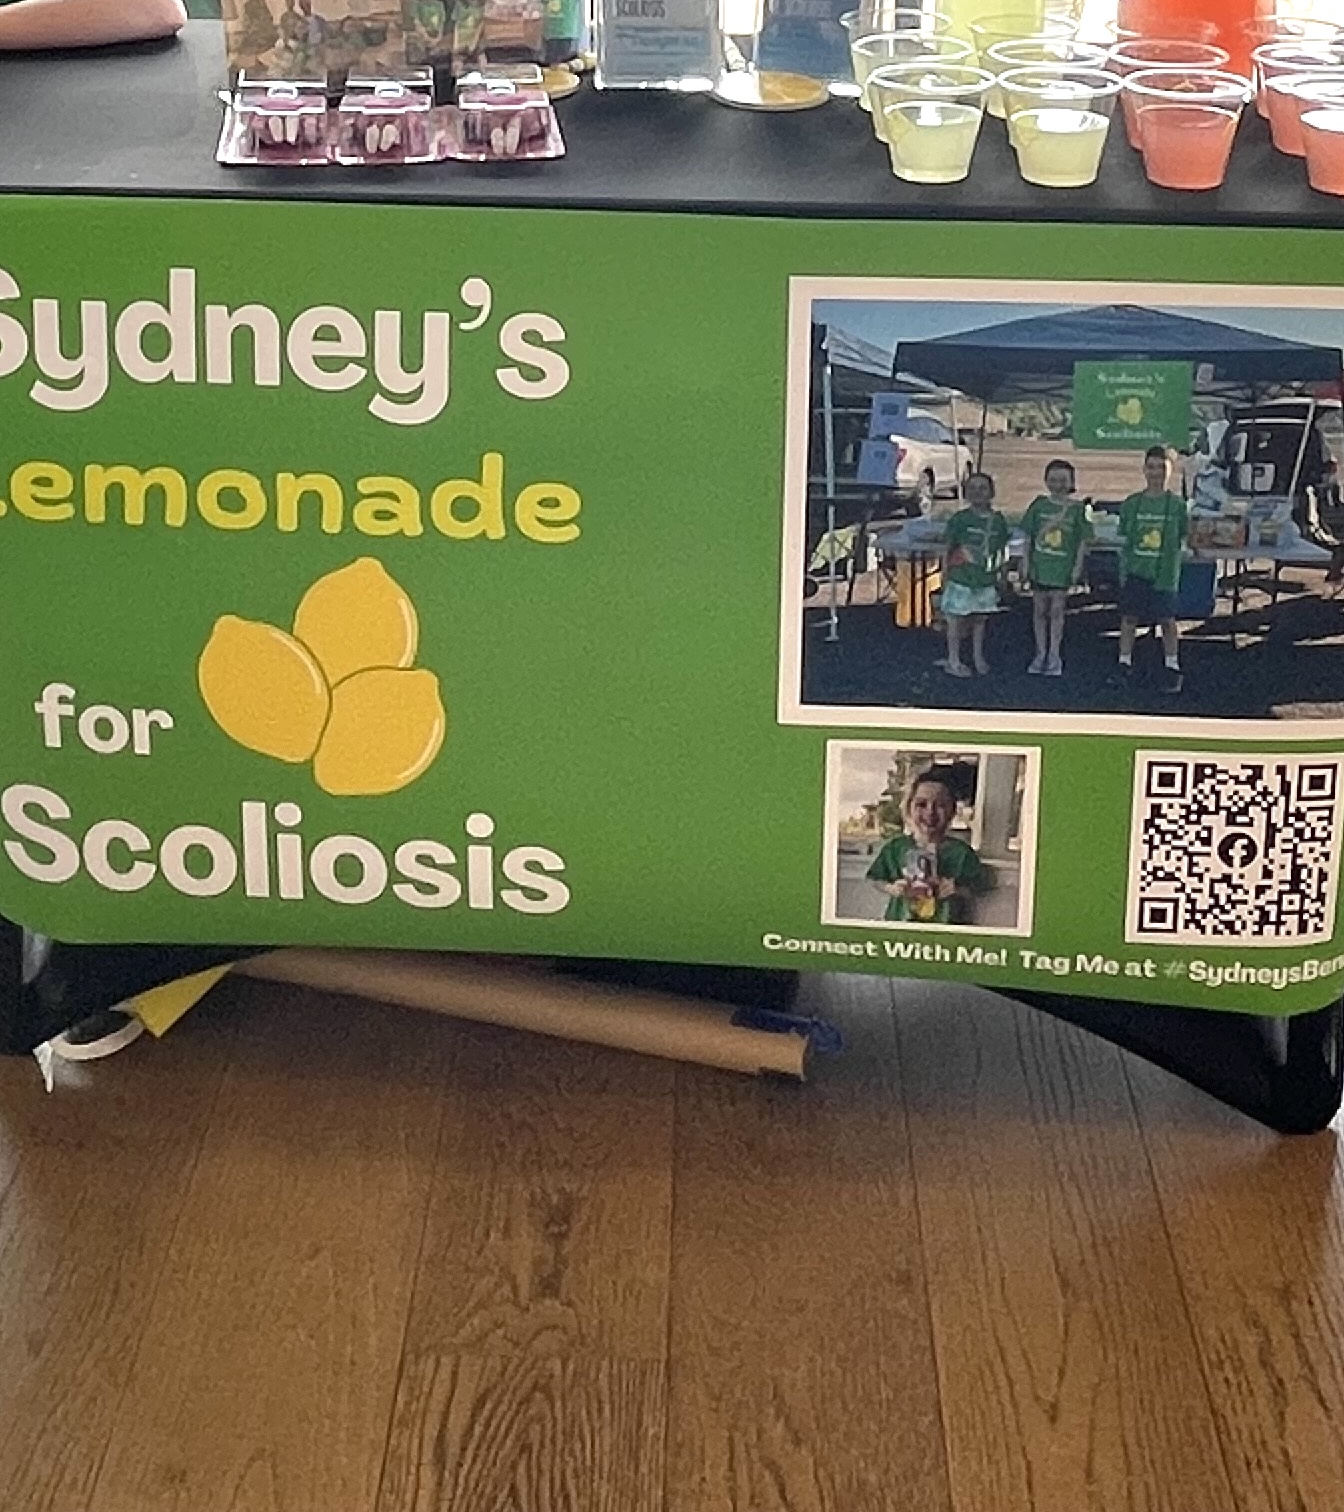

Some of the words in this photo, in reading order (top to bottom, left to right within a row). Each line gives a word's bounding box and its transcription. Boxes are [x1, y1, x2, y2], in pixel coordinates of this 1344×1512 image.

[34, 682, 174, 756] for
[0, 784, 571, 915] Scoliosis
[761, 933, 879, 958] Connect
[883, 941, 950, 962] With
[956, 945, 1008, 968] Me!
[1019, 950, 1070, 976] Tag
[1076, 954, 1120, 975] Me
[1124, 958, 1158, 978] at
